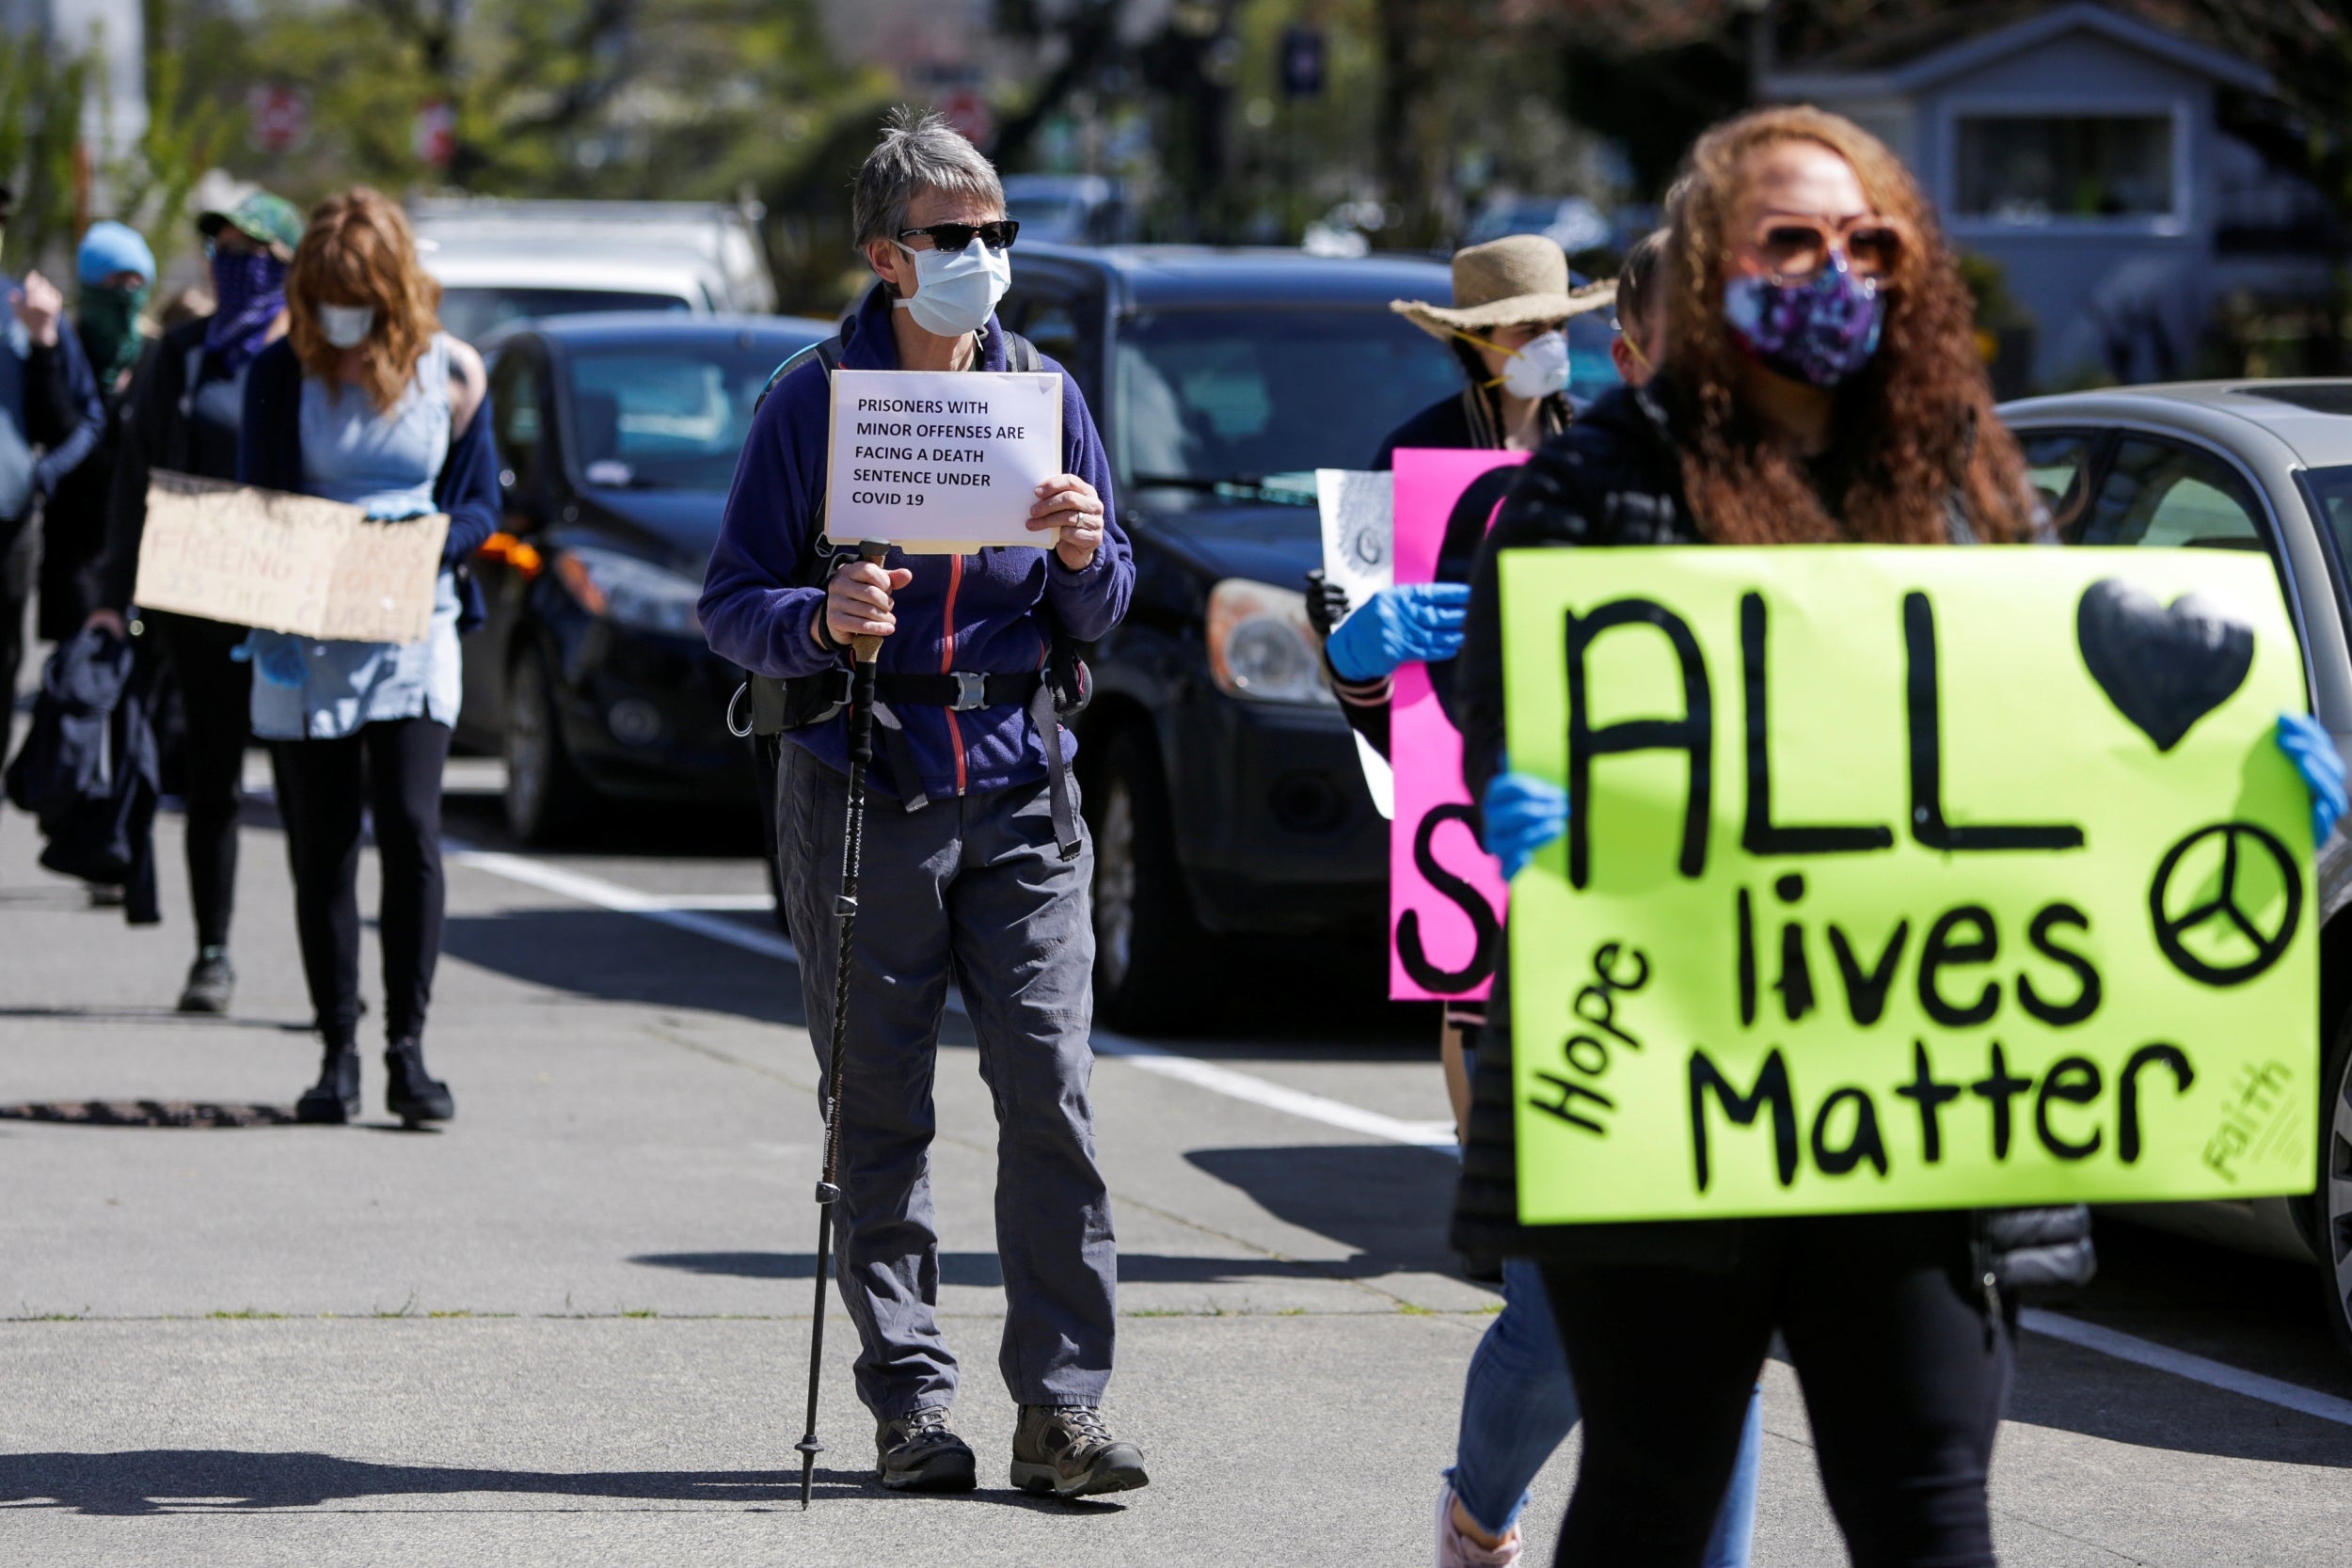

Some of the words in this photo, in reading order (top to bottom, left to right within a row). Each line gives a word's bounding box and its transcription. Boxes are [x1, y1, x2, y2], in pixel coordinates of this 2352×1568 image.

[858, 398, 944, 414] PRISONERS
[946, 401, 988, 415] WITH
[856, 422, 912, 437] MINOR
[915, 423, 992, 439] OFFENSES
[995, 426, 1025, 439] ARE
[855, 446, 913, 461] FACING
[916, 448, 929, 461] A
[932, 449, 984, 464] DEATH
[852, 468, 932, 484] SENTENCE
[936, 472, 991, 487] UNDER
[851, 491, 901, 505] COVID
[906, 493, 925, 506] 19
[1562, 590, 2086, 893] ALL
[842, 835, 851, 877] Diamond
[1736, 871, 2104, 1029] lives
[1529, 941, 1651, 1136] Hope
[1687, 1038, 2196, 1194] Matter
[823, 1130, 832, 1168] Diamond
